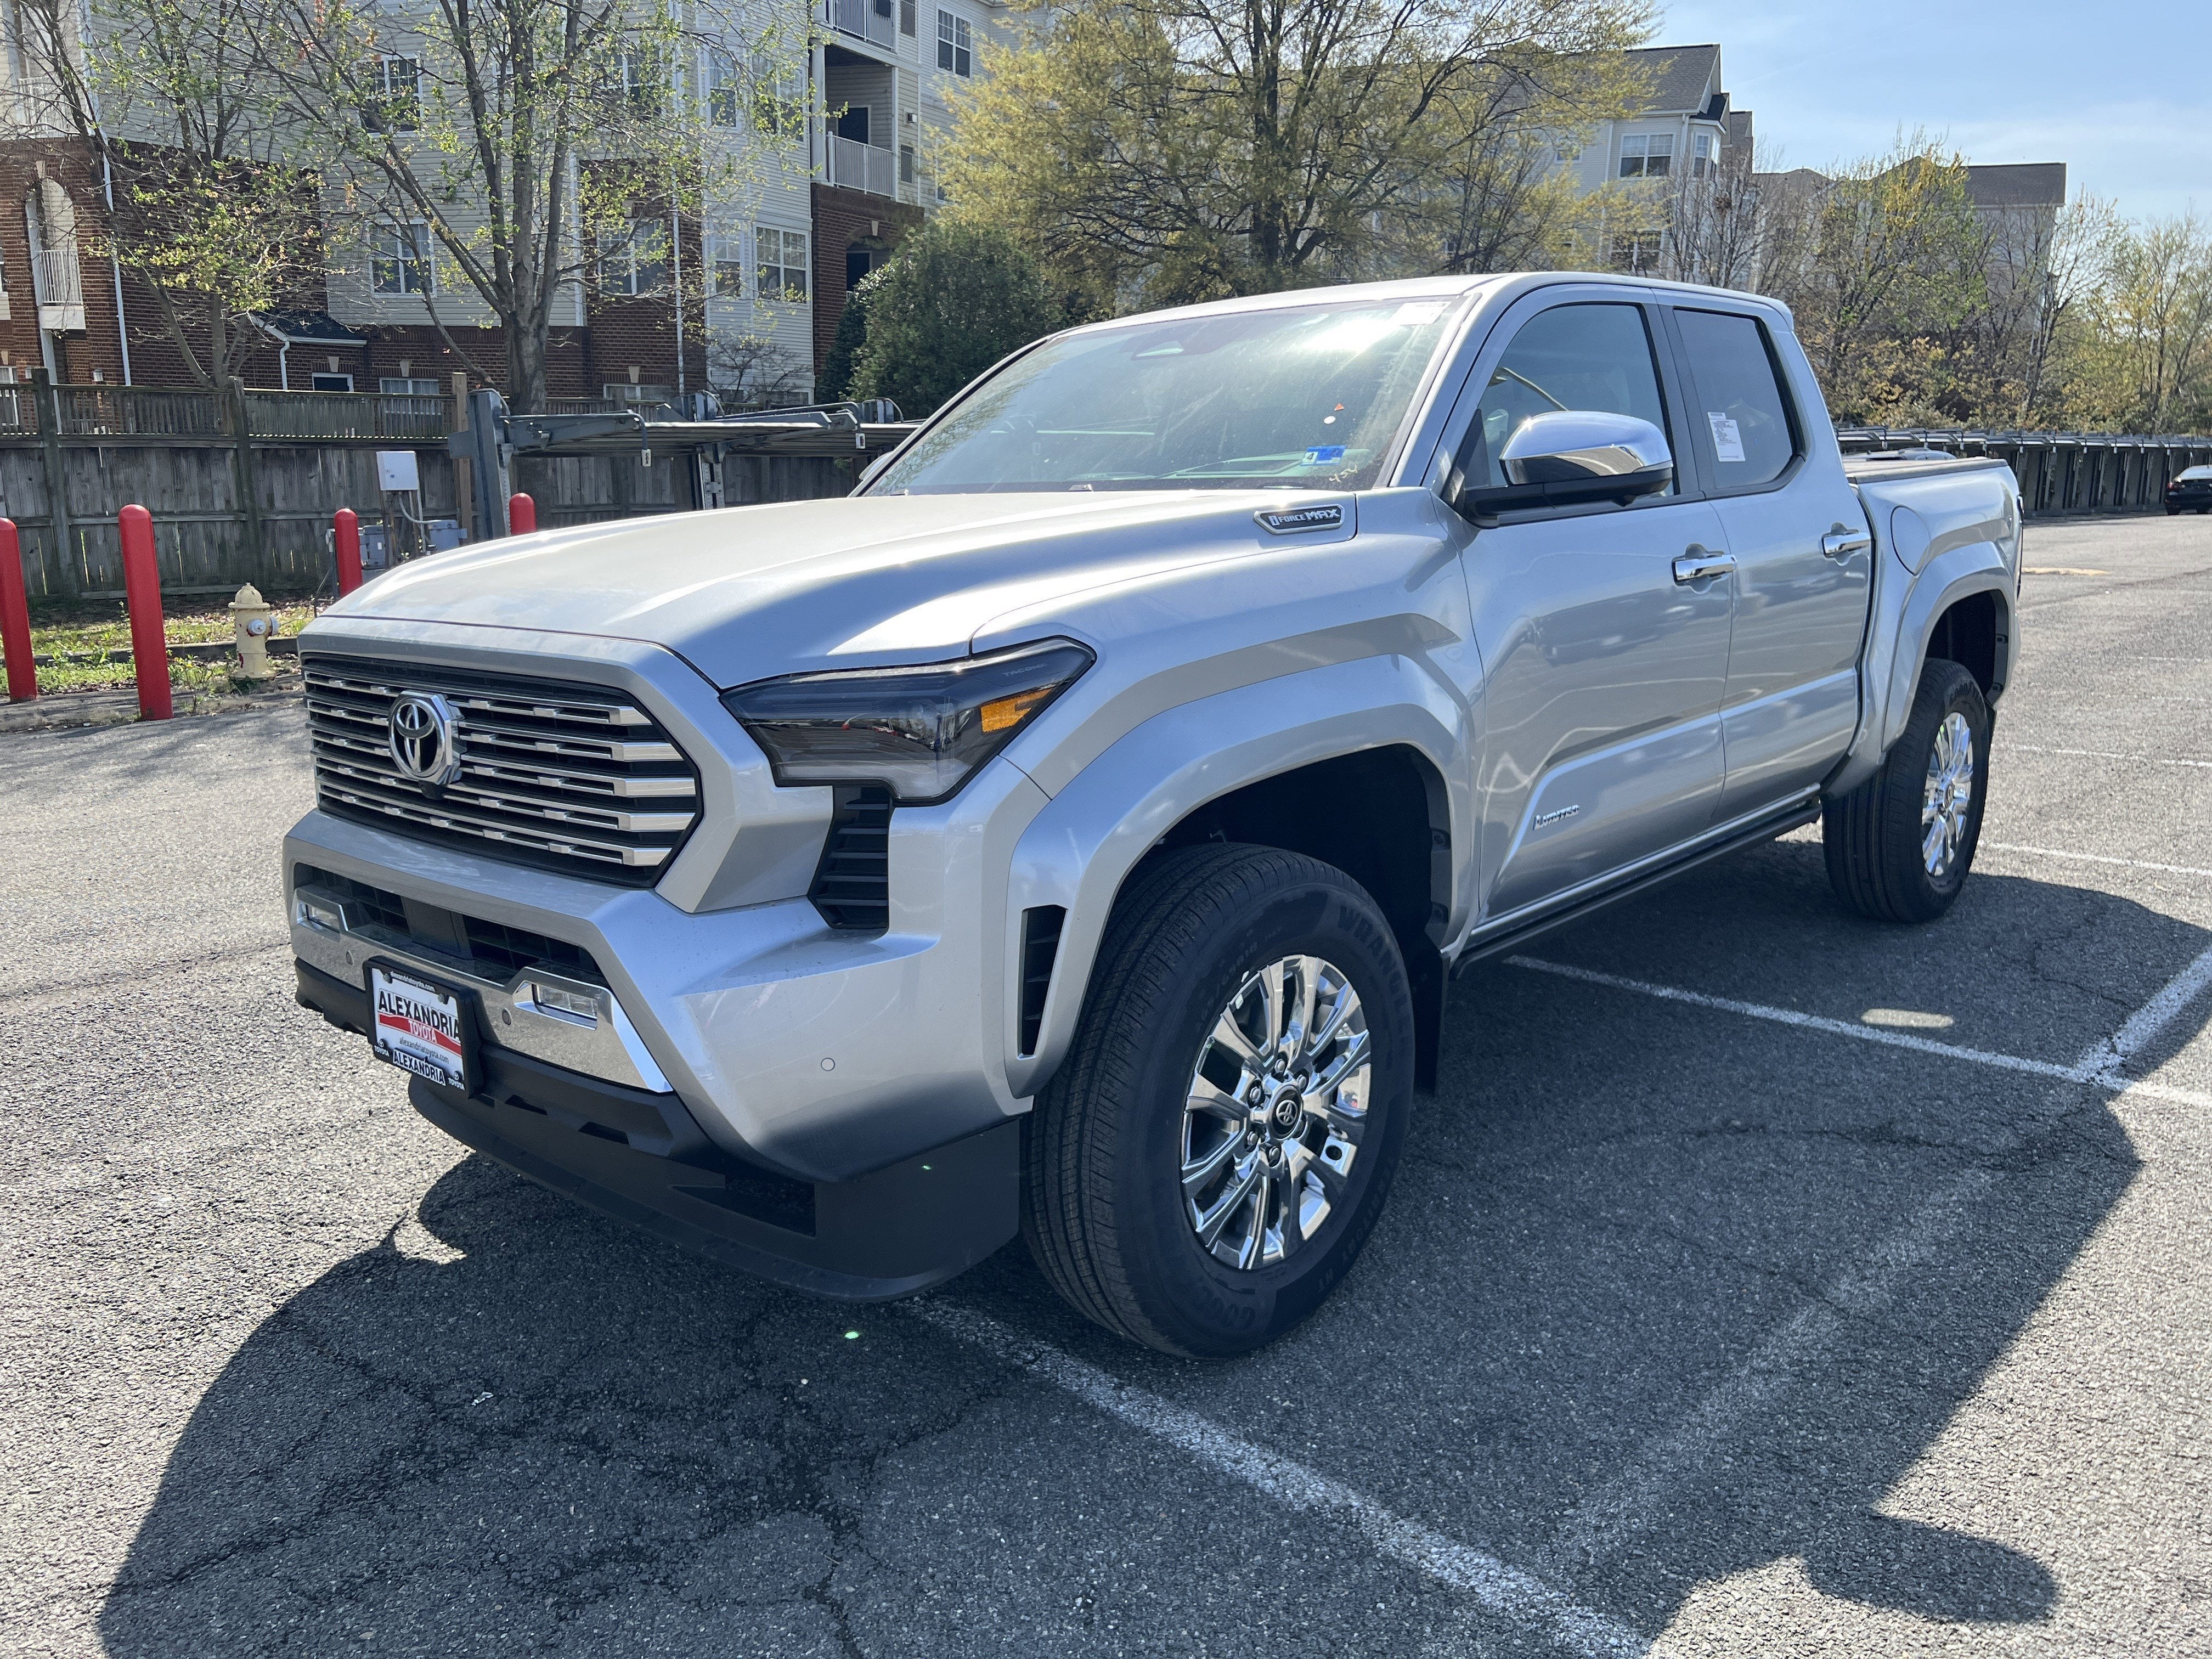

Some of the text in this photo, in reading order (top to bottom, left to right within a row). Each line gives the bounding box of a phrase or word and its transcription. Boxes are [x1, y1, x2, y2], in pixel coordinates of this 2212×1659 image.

[379, 990, 460, 1040] ALEXANDRIA
[408, 1019, 437, 1043] TOYOTA
[399, 1036, 449, 1064] alexandriatoyota.com
[393, 1050, 445, 1085] ALEXANDRIA
[448, 1077, 465, 1091] TOYOTA
